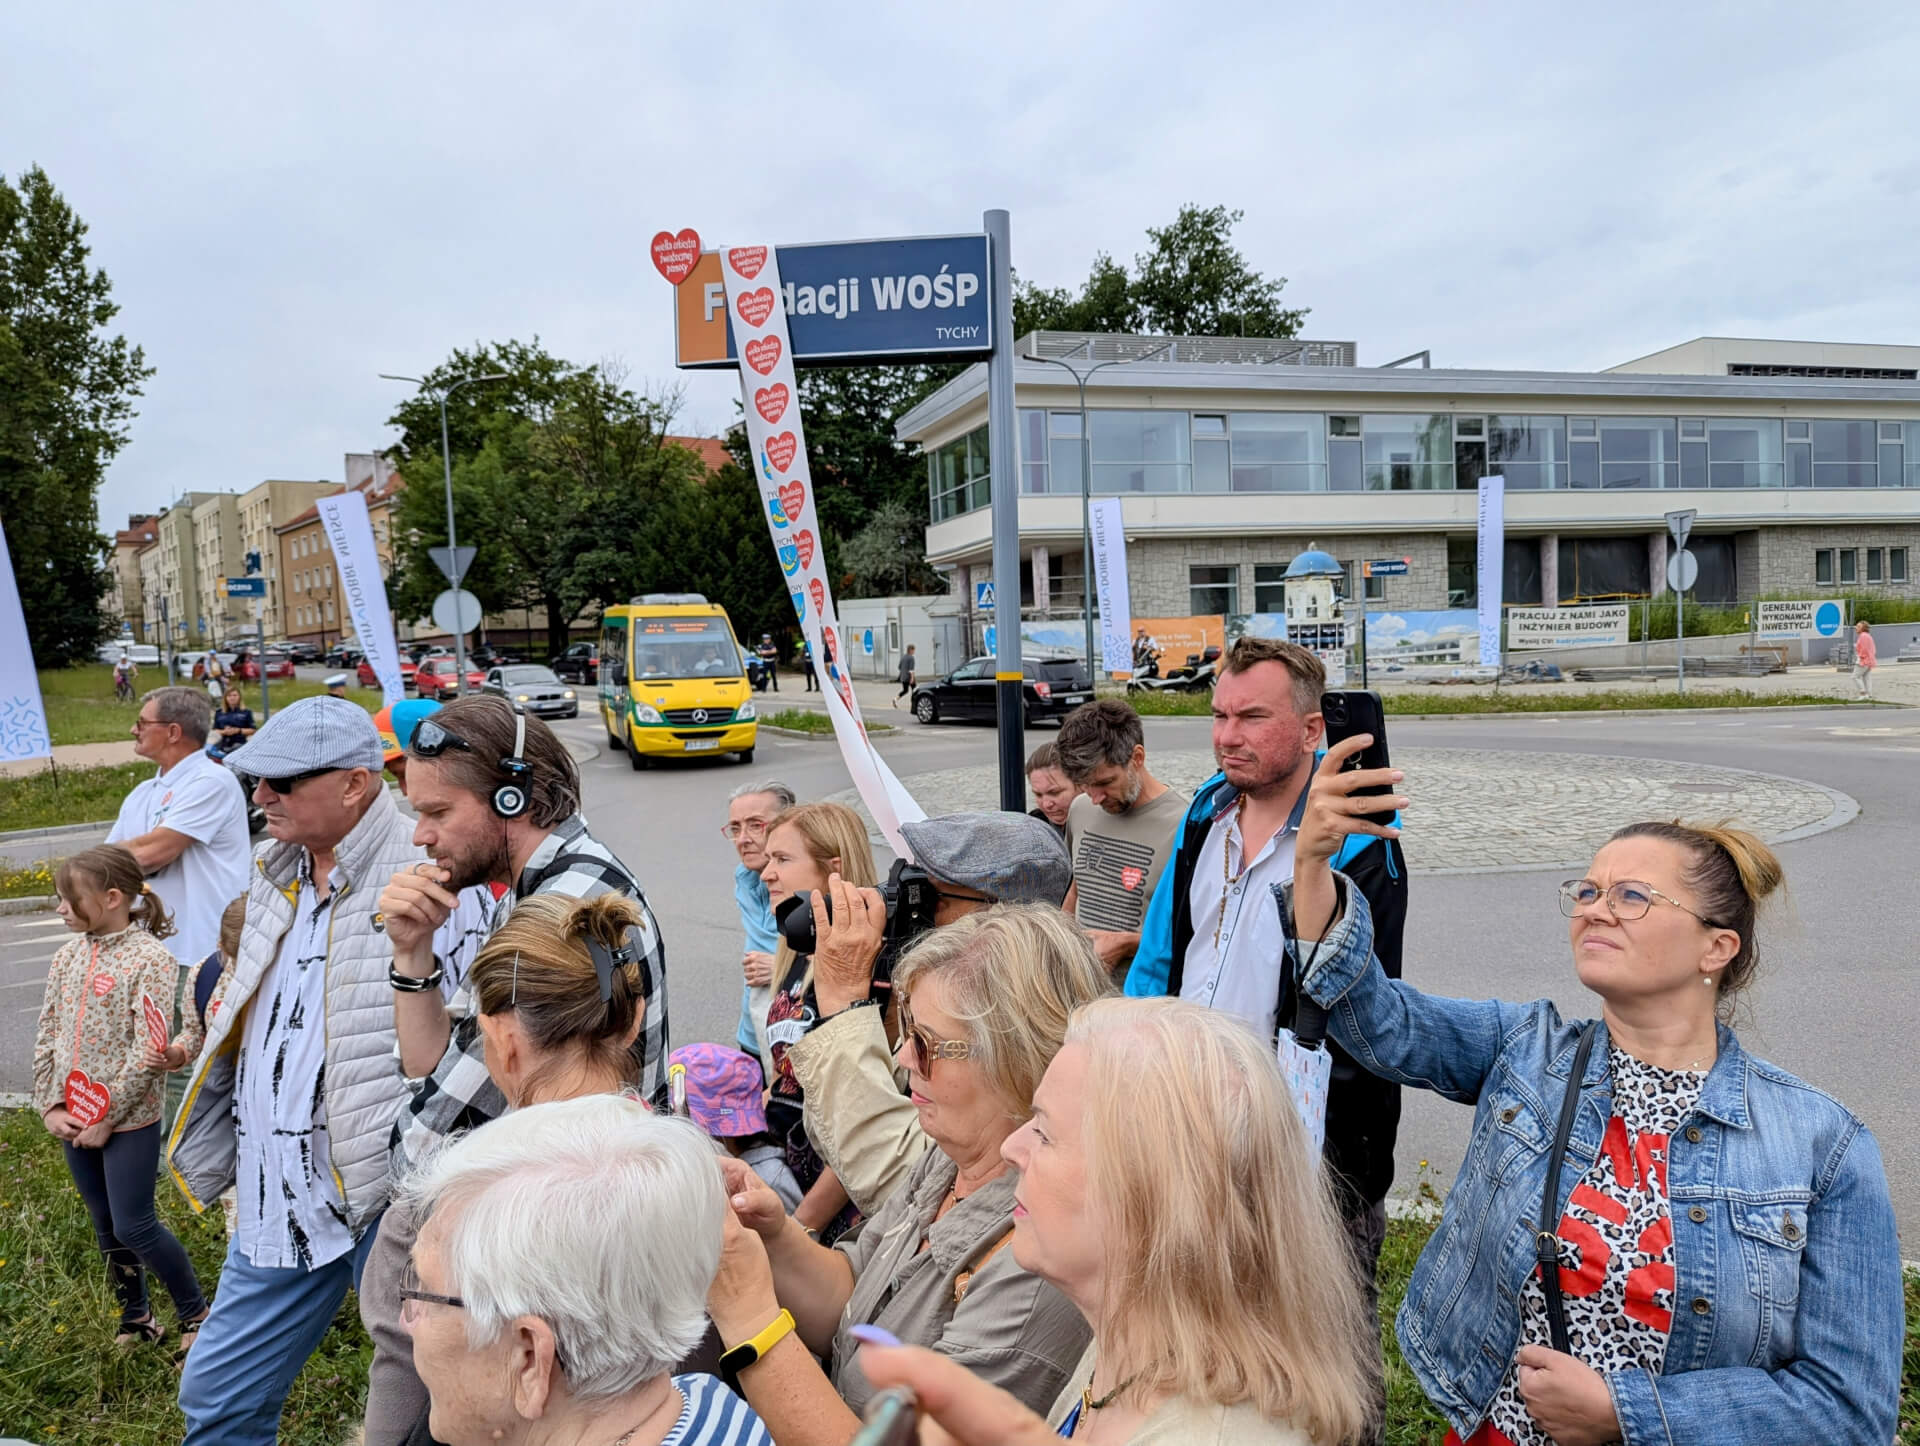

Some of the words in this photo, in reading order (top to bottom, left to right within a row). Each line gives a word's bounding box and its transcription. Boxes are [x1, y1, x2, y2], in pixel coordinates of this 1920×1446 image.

[704, 278, 859, 321] Fdacji
[871, 264, 979, 311] WOŚP
[935, 326, 979, 340] TYCHY
[1762, 603, 1813, 612] GENERALNY
[1511, 612, 1556, 620] PRACUJ
[1570, 611, 1596, 619] NAMI
[1599, 609, 1626, 618] JAKO
[1762, 613, 1812, 621] WYKONAWCA
[1519, 622, 1572, 631] INŻYNIER
[1575, 621, 1619, 630] BUDOWY
[1762, 622, 1812, 631] INWESTYCJI
